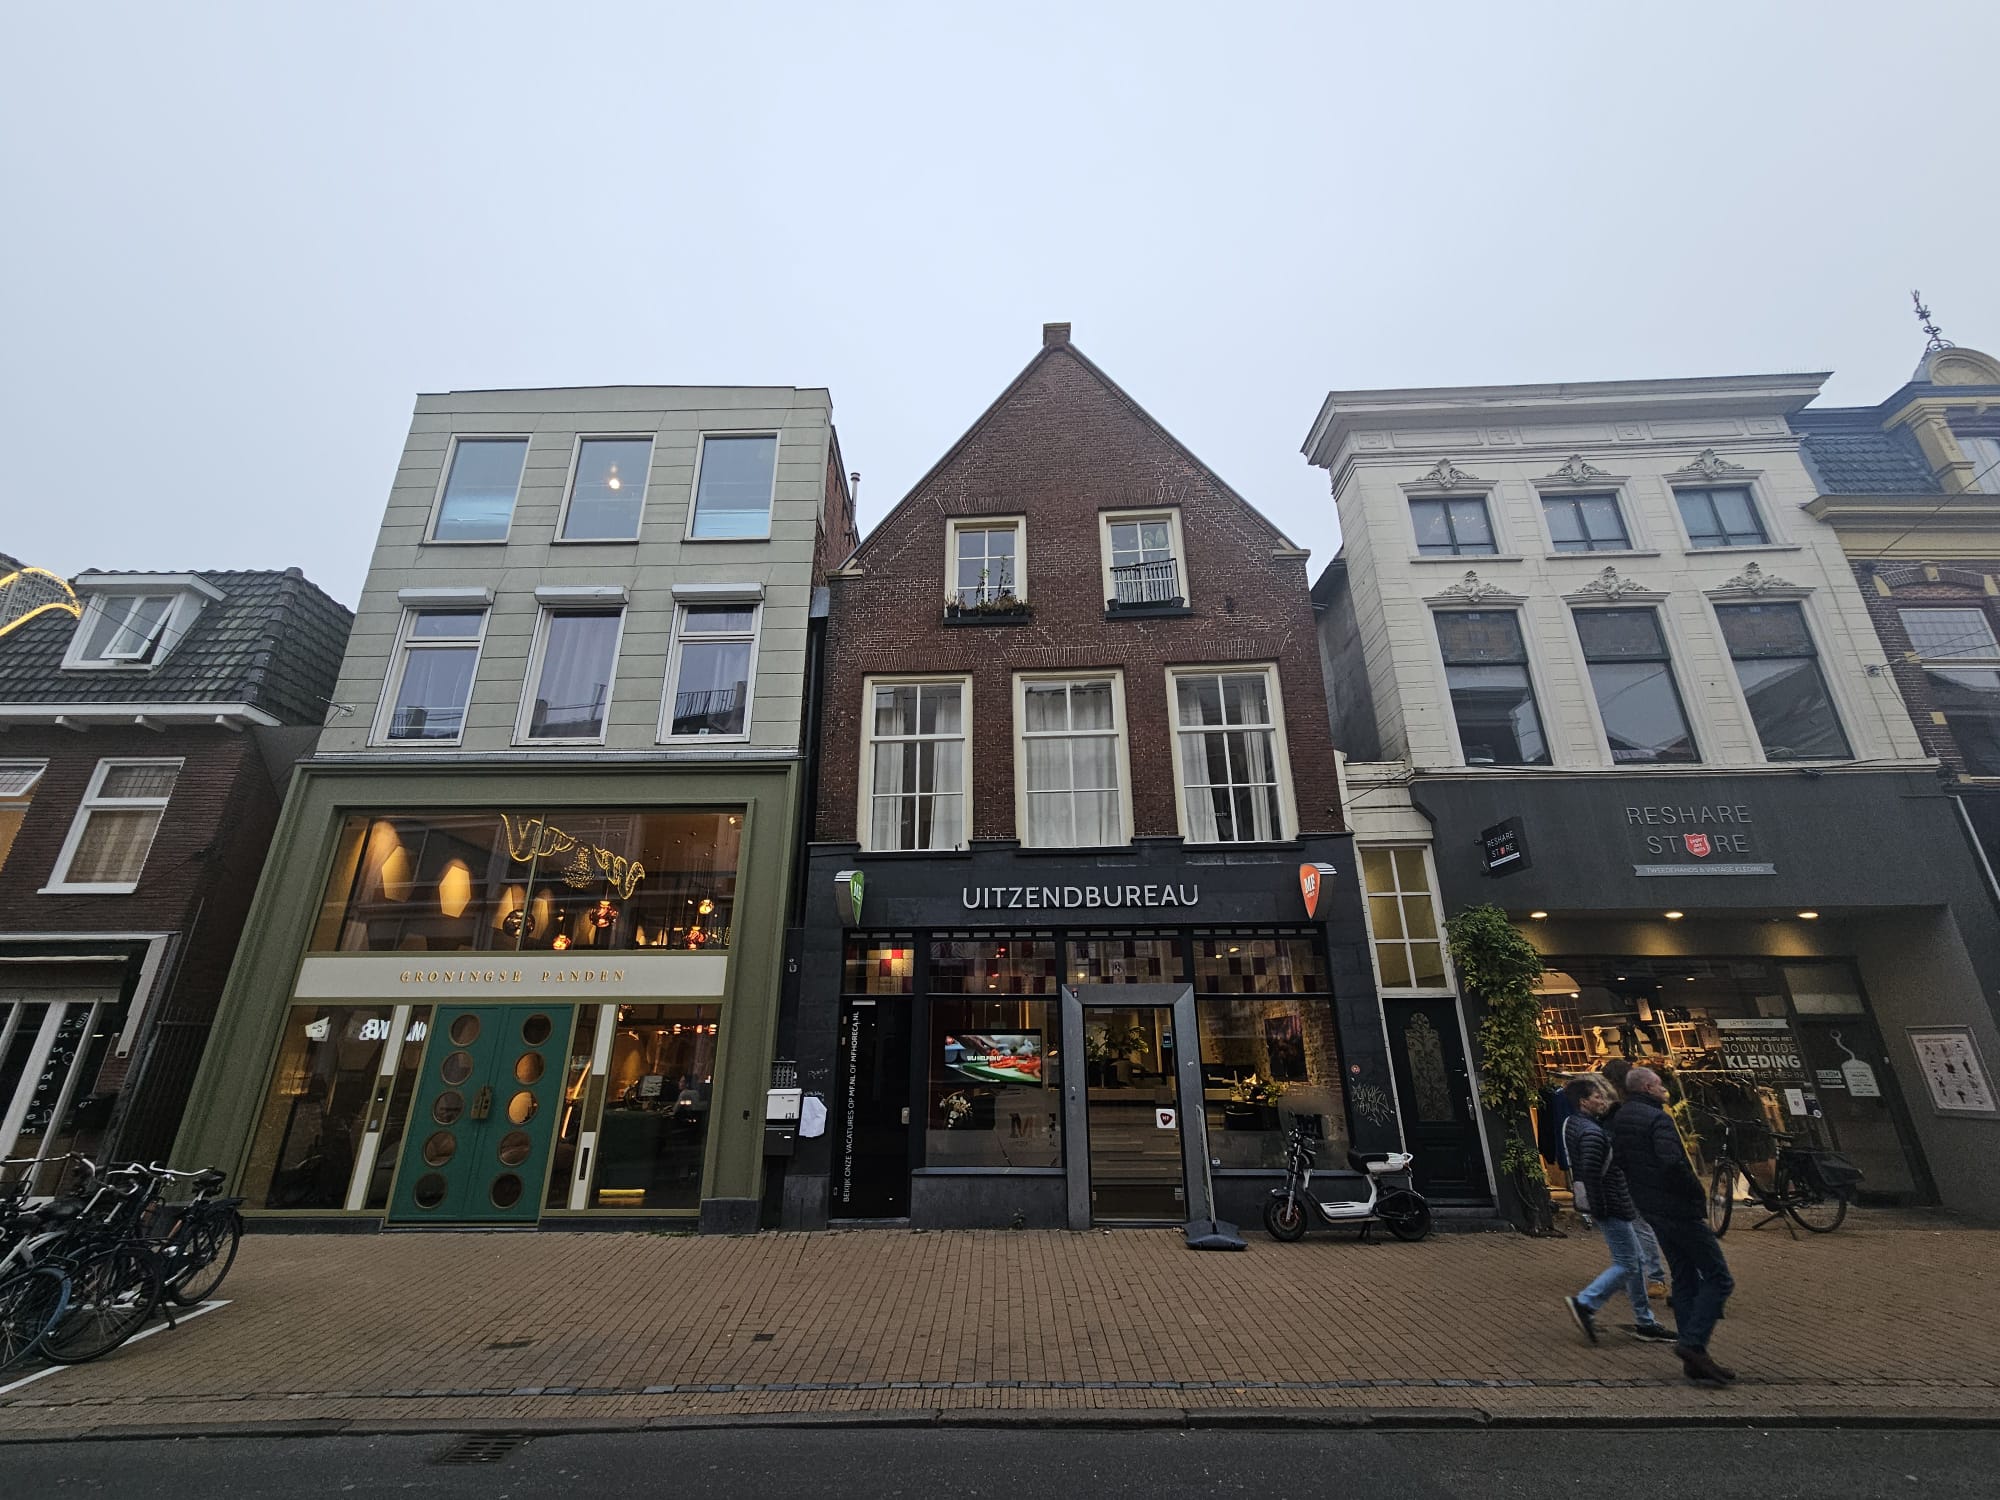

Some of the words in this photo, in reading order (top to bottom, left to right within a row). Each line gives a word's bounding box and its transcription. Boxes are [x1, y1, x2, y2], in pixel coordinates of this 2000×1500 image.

[1626, 805, 1752, 825] RESHARE
[1487, 830, 1514, 848] RESHARE
[1647, 833, 1750, 856] STRE
[962, 884, 1199, 909] UITZENDBUREAU
[400, 970, 522, 983] GRONINGSE
[541, 969, 626, 983] PANDEN
[850, 1011, 860, 1062] MFHORECA.NL
[1722, 1043, 1759, 1053] JOUW
[1763, 1043, 1797, 1053] OUDE
[850, 1063, 857, 1074] OF
[1725, 1054, 1801, 1069] KLEDING
[848, 1075, 856, 1097] MF.NL
[848, 1097, 855, 1109] OP
[846, 1110, 854, 1154] VACATURES
[844, 1155, 852, 1177] ONZE
[843, 1178, 852, 1203] BEKIJK
